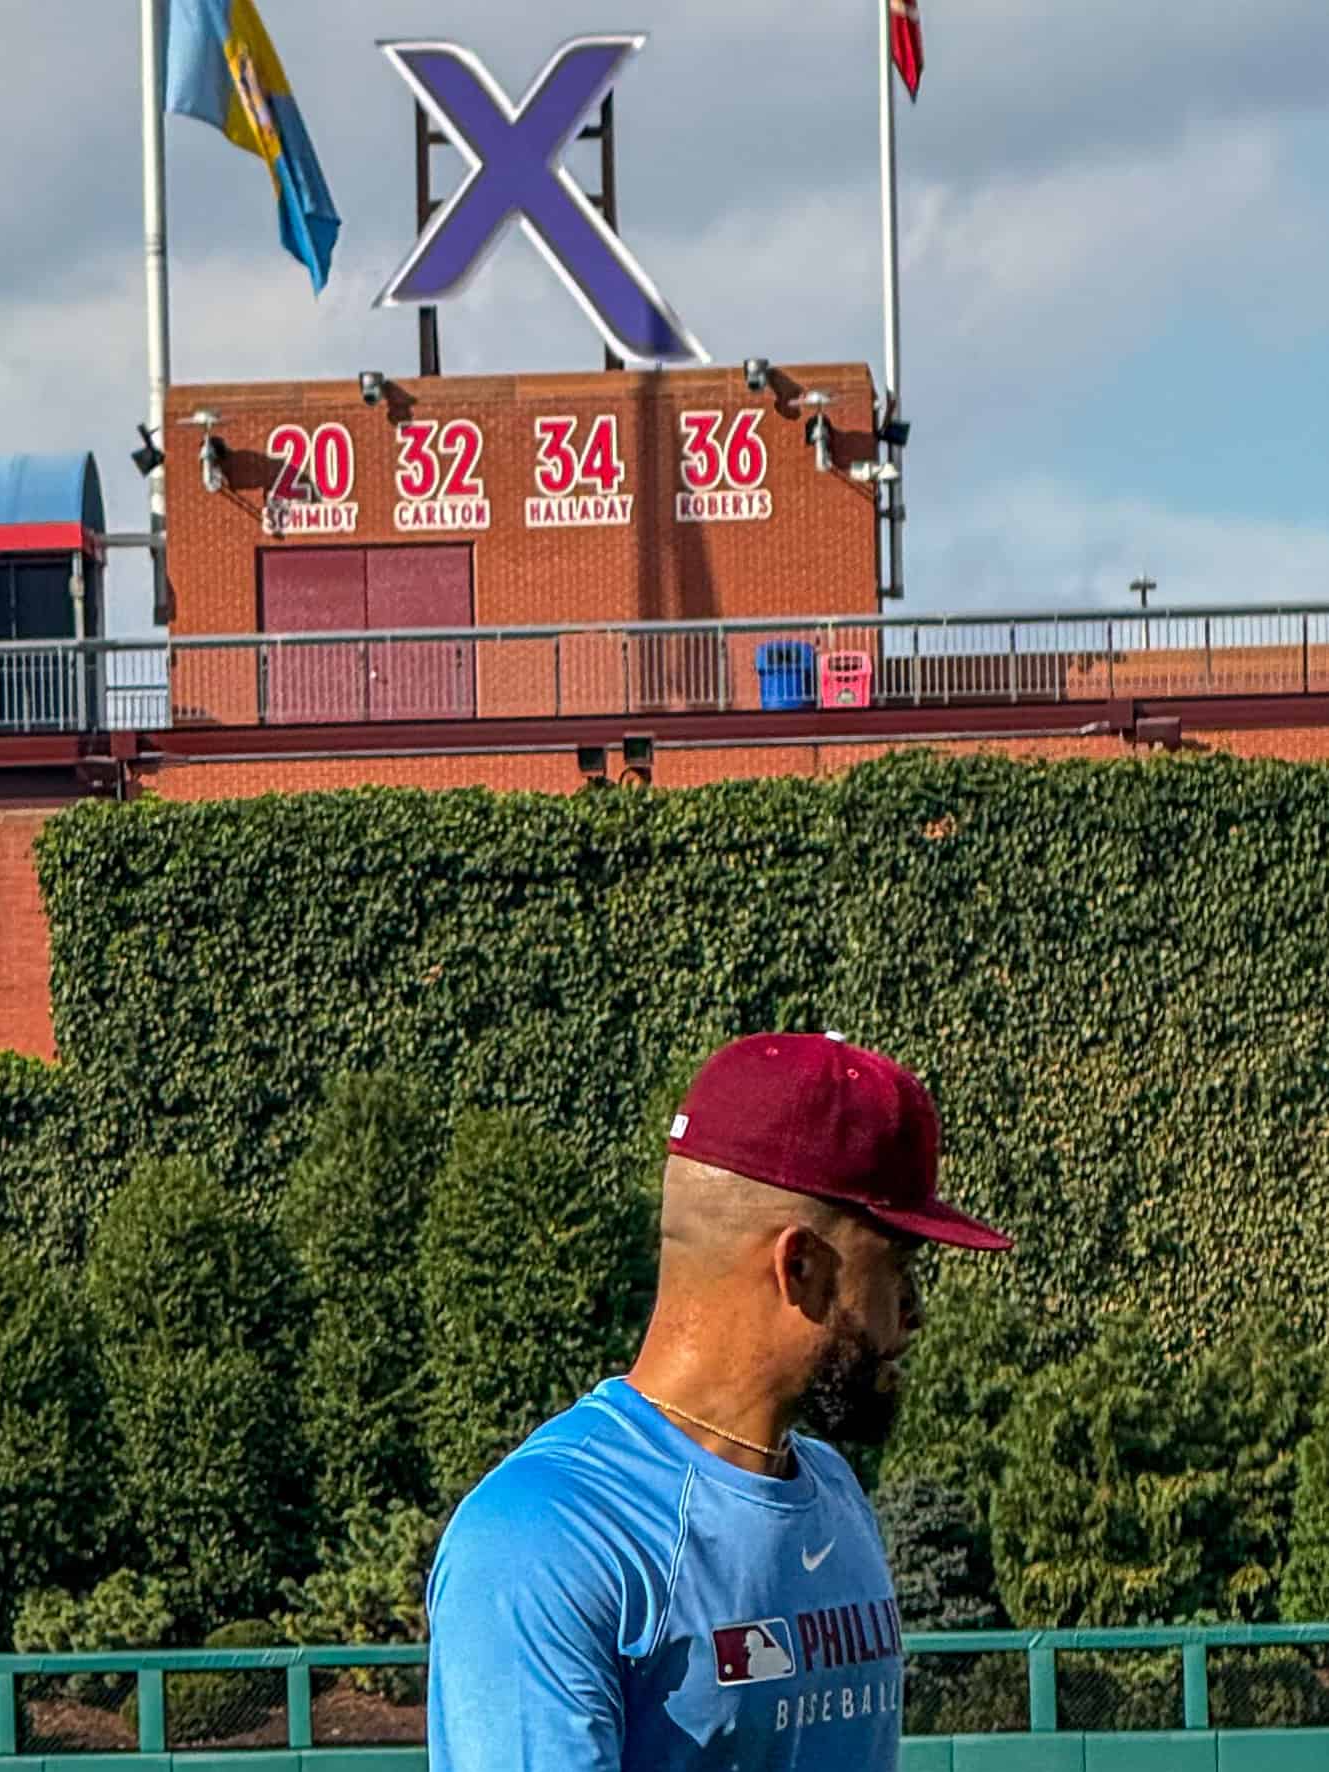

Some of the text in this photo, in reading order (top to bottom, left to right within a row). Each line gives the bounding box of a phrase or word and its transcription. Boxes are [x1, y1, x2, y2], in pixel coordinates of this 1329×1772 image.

[267, 424, 354, 502] 20
[396, 419, 484, 501] 32
[534, 414, 625, 496] 34
[680, 408, 767, 489] 36
[265, 504, 356, 531] SCHMIDT
[397, 503, 488, 527] CARLTON
[528, 498, 631, 523] HALLADAY
[679, 492, 771, 518] ROBERTS
